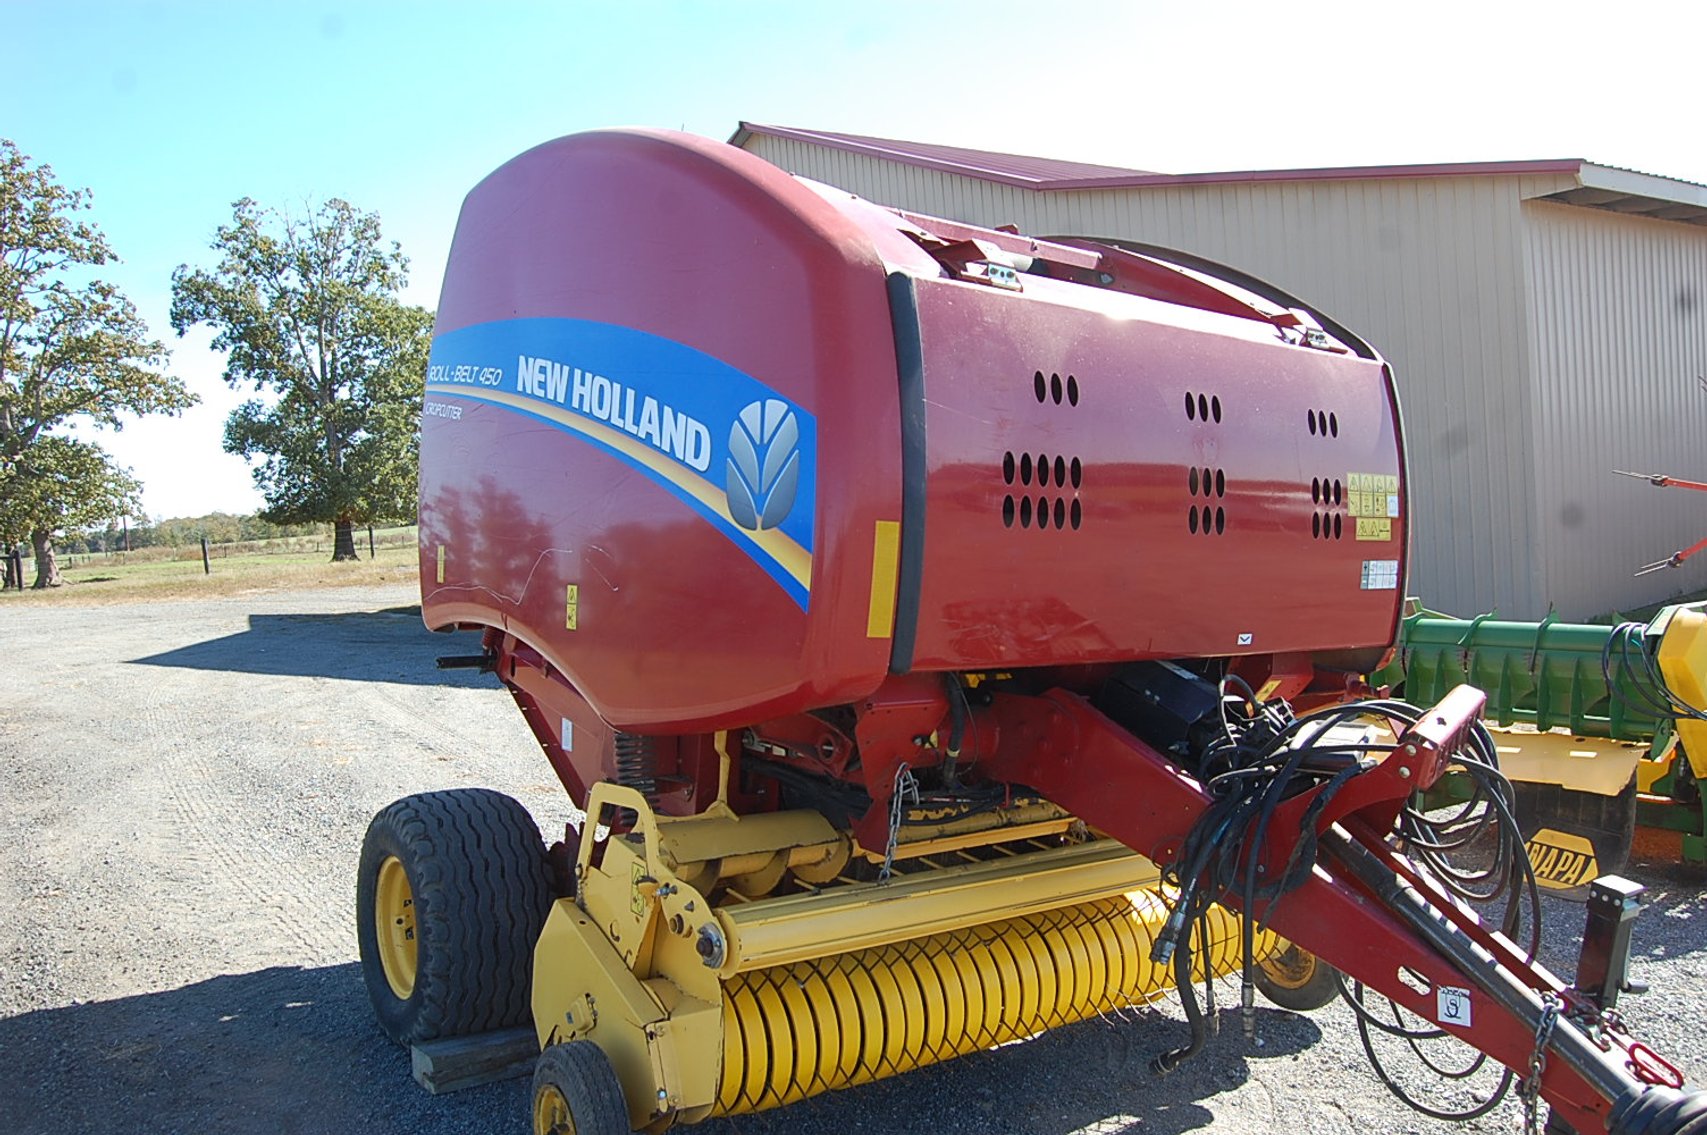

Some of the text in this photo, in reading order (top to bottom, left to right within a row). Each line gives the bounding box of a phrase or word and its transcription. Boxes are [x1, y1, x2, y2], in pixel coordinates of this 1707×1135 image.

[478, 367, 503, 387] 450
[516, 354, 711, 473] NEW HOLLAND
[1527, 842, 1587, 884] NAPA
